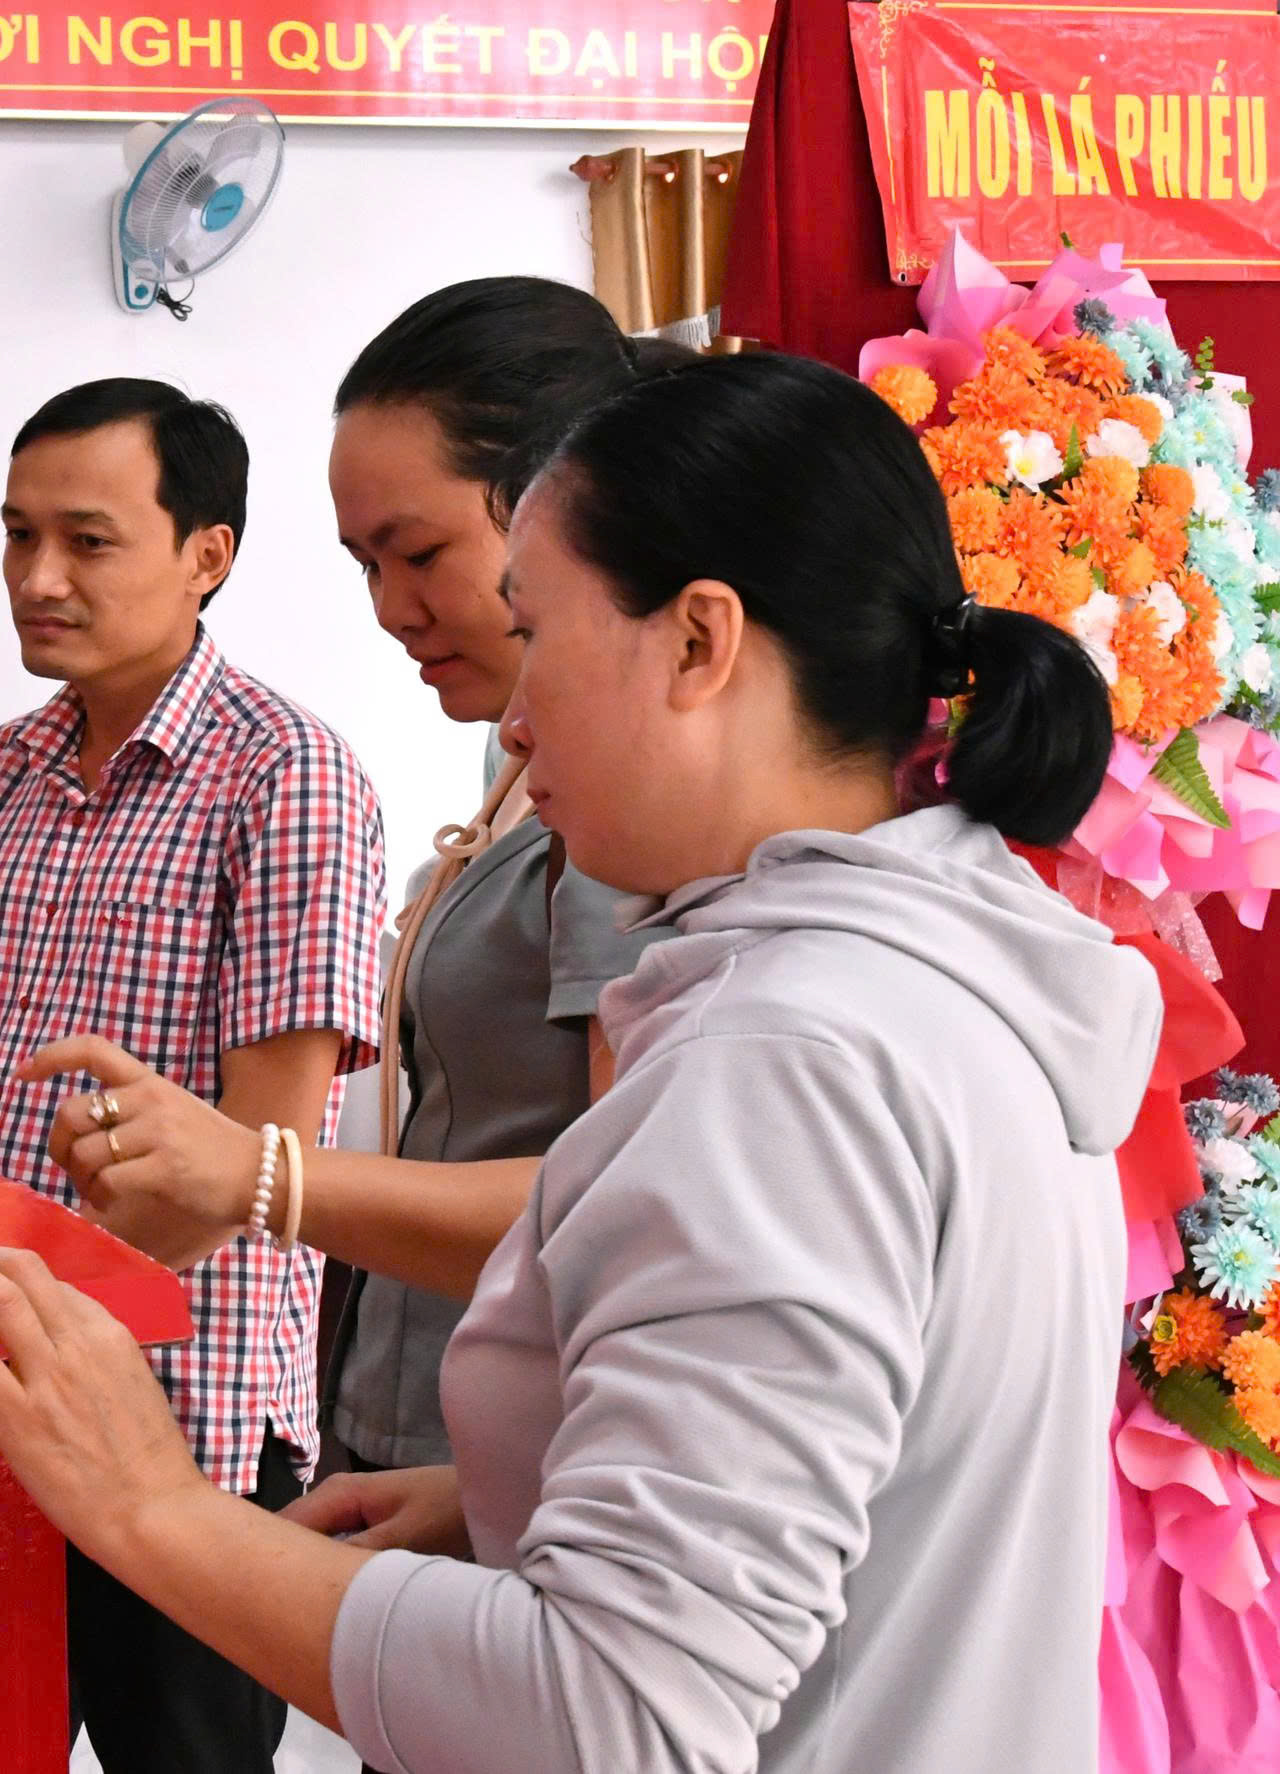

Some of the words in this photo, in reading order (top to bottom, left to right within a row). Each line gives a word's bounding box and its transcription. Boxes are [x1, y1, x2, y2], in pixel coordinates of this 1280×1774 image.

[68, 15, 243, 81] NGHỊ
[267, 13, 505, 76] QUYẾT
[526, 26, 637, 89] ĐẠI
[924, 56, 1033, 199] MỖI
[1040, 75, 1111, 197] LÁ
[1115, 59, 1268, 202] PHIẾU
